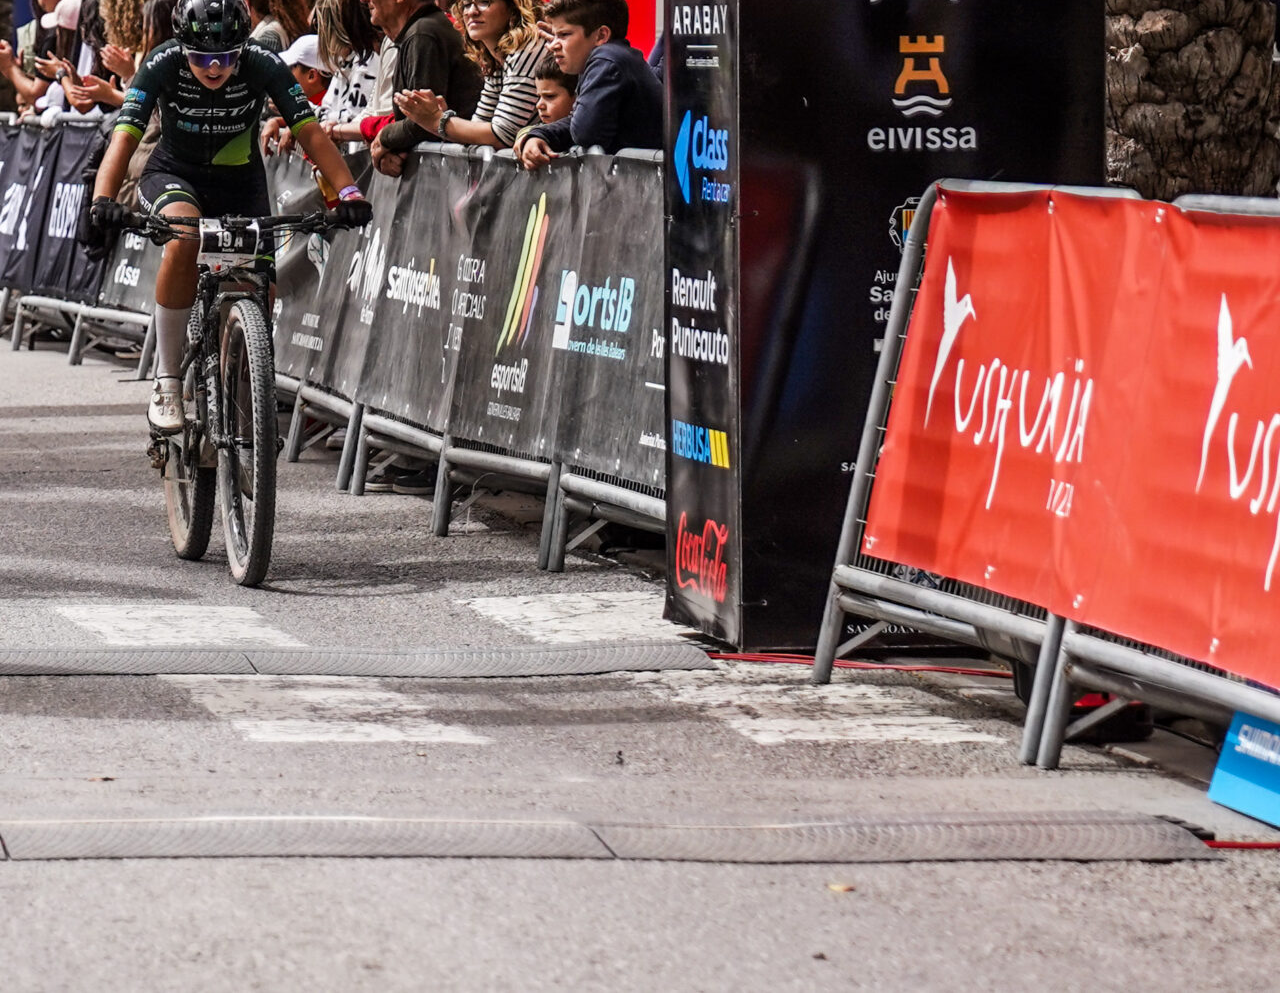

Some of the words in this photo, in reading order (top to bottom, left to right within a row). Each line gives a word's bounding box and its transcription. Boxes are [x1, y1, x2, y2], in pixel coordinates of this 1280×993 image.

[672, 4, 728, 36] ARABAY
[692, 115, 729, 172] Class
[216, 231, 232, 247] 19
[234, 237, 244, 247] A
[672, 268, 717, 312] Renault
[671, 316, 730, 366] Punicauto
[672, 418, 712, 465] HERBUSA
[847, 623, 871, 635] SAN
